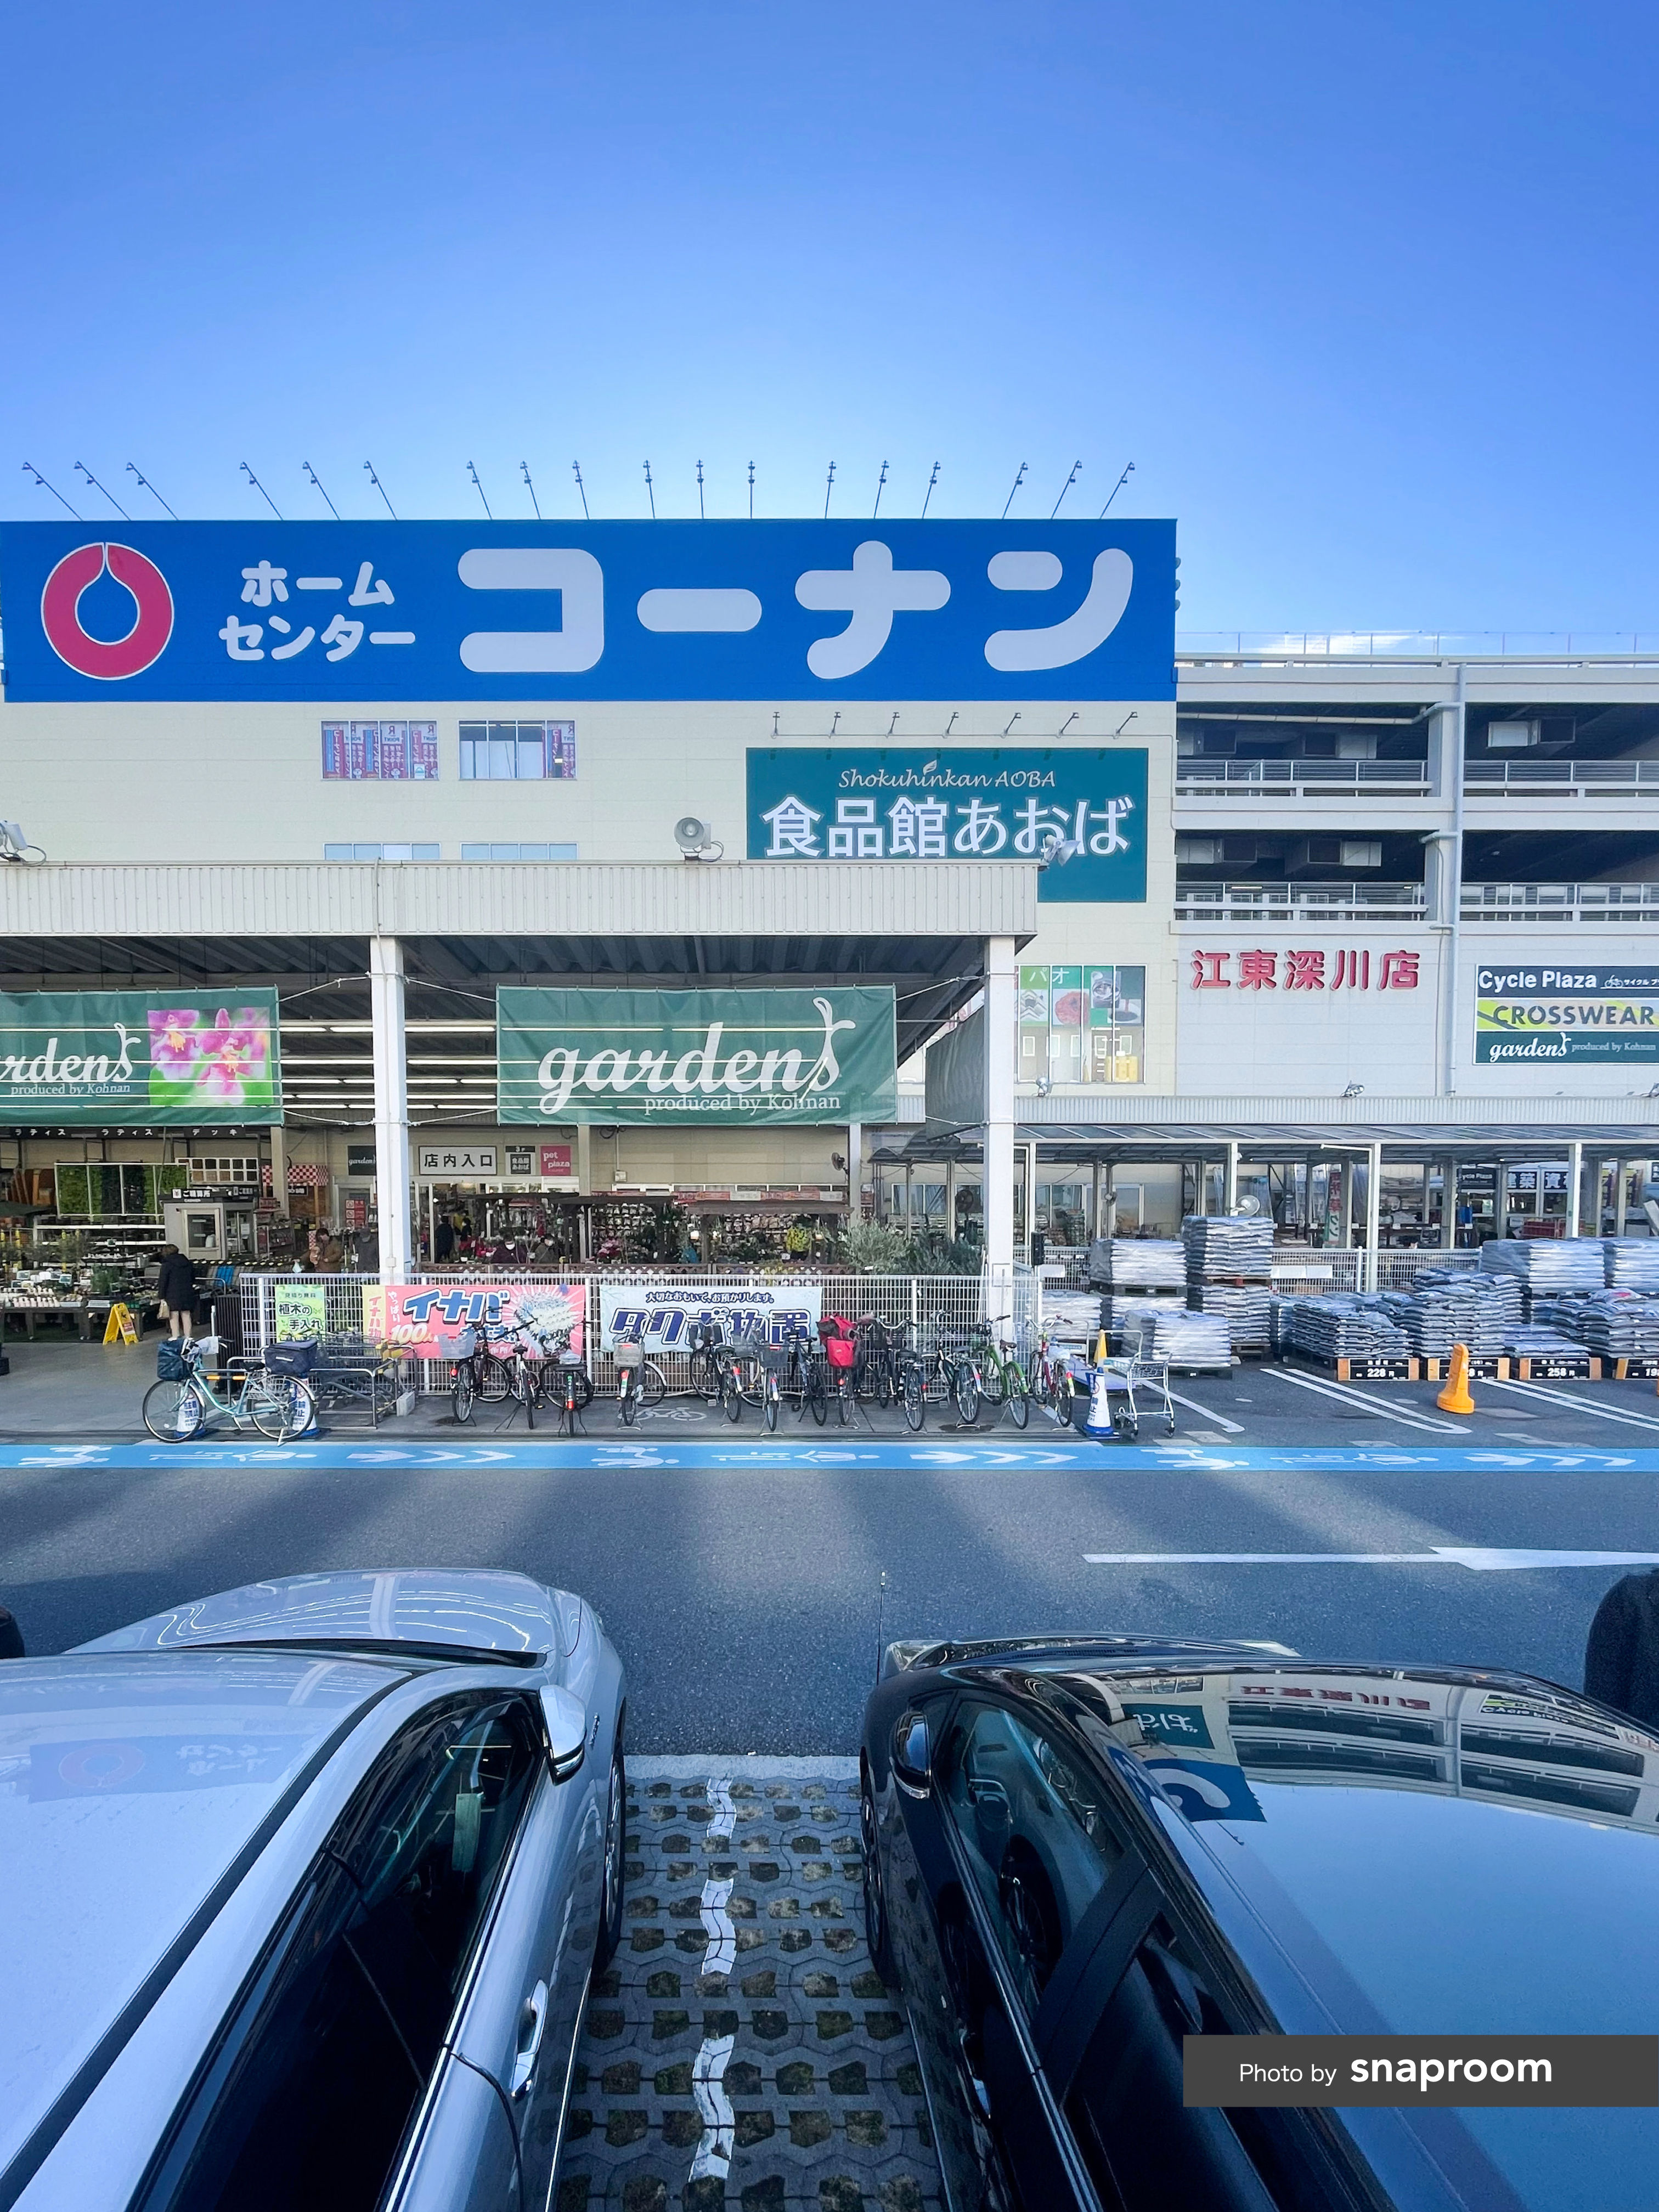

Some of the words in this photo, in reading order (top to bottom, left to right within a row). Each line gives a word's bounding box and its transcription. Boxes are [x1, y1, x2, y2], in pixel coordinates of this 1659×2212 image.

[241, 560, 395, 607] ホーム
[458, 540, 1133, 680] コーナン
[219, 614, 416, 662] センター
[838, 760, 992, 788] Shokuhinkan
[995, 770, 1056, 788] AOBA
[762, 795, 1133, 857] 食品館あおば
[1192, 950, 1421, 991] 江東深川店
[1479, 970, 1537, 993] Cycle
[1542, 970, 1598, 988] Plaza
[1493, 1005, 1655, 1025] CROSSWEAR
[0, 1022, 142, 1083] rdens
[538, 996, 856, 1115] gardens
[1489, 1032, 1572, 1063] gardens
[10, 1083, 65, 1096] produced
[69, 1083, 84, 1095] by
[87, 1082, 131, 1094] Kohnan
[644, 1094, 733, 1116] produced
[738, 1094, 762, 1116] by
[767, 1093, 841, 1111] Kohnan
[101, 1128, 154, 1136] ラティス
[424, 1153, 493, 1167] 店内入口
[279, 1304, 311, 1314] 植木の
[403, 1288, 511, 1323] イナバ
[645, 1291, 775, 1304] 大切なおもいで、お預かりします。
